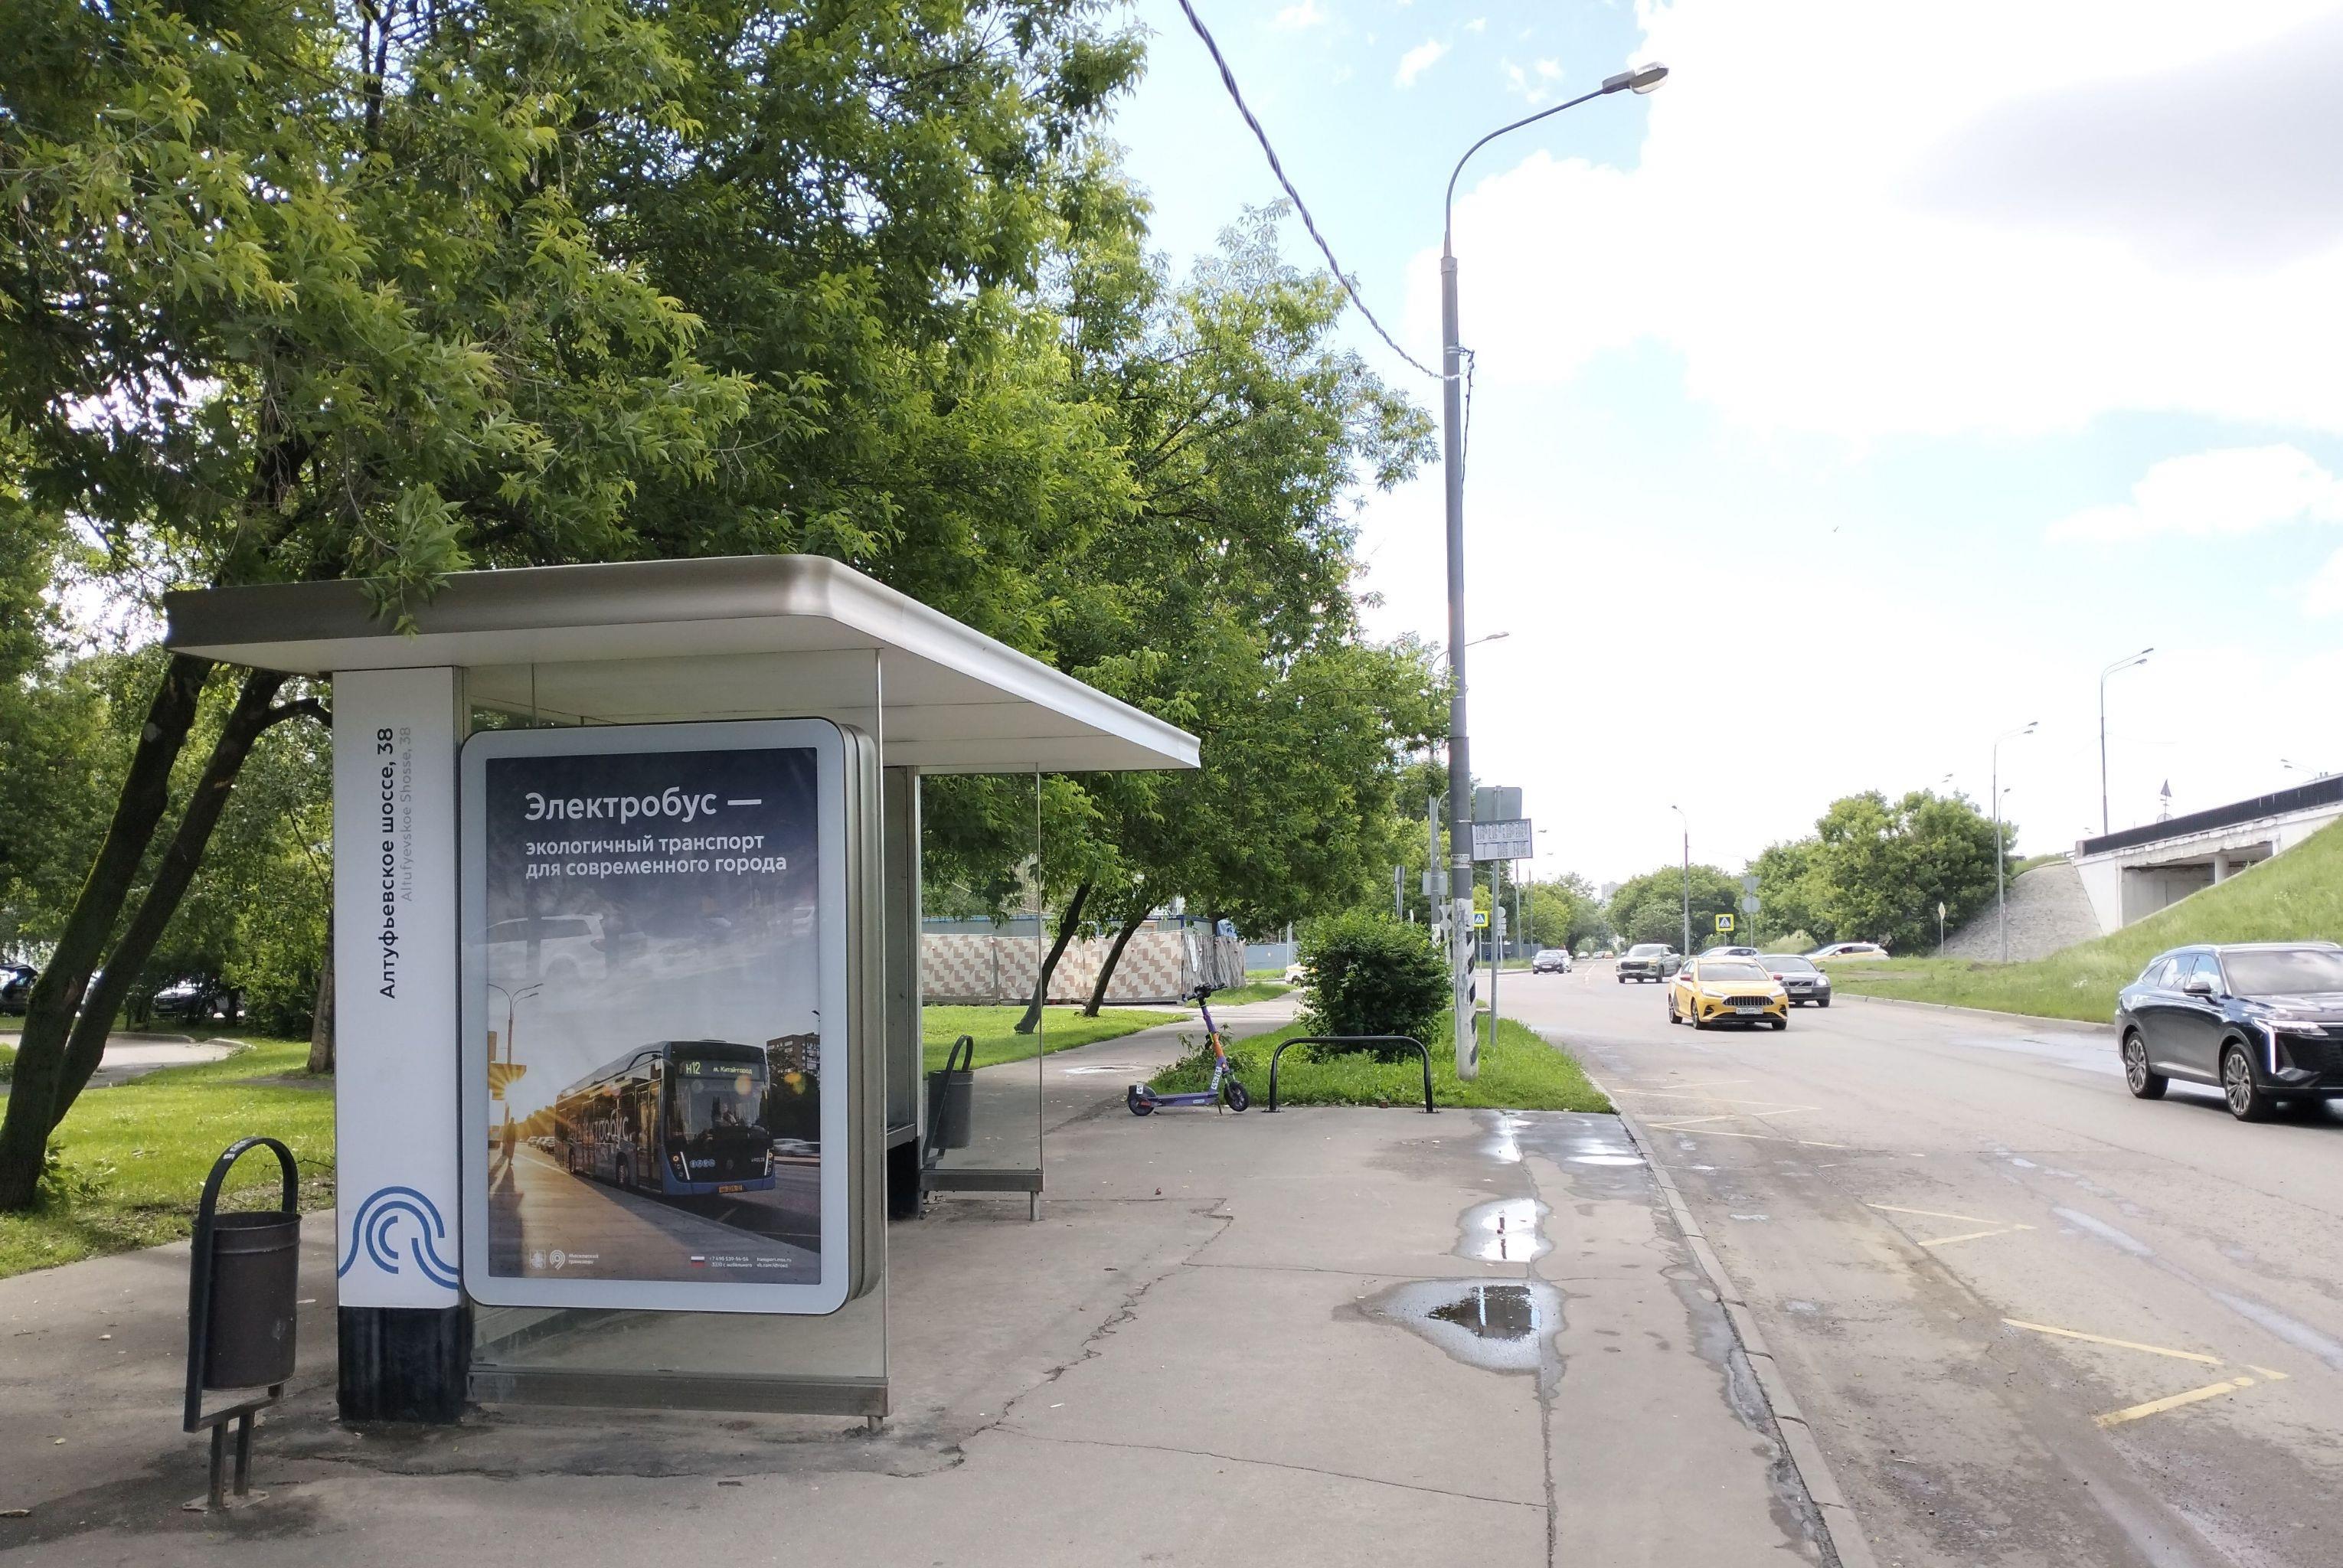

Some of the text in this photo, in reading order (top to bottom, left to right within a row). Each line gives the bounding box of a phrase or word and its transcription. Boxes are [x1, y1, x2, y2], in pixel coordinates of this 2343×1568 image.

[399, 727, 414, 902] Altufyevskoe Shosse, 38
[524, 786, 717, 824] Электробус
[377, 727, 399, 999] Алтуфьевское шоссе, 38
[526, 833, 764, 856] экологичный транспорт
[525, 854, 787, 879] для современного города
